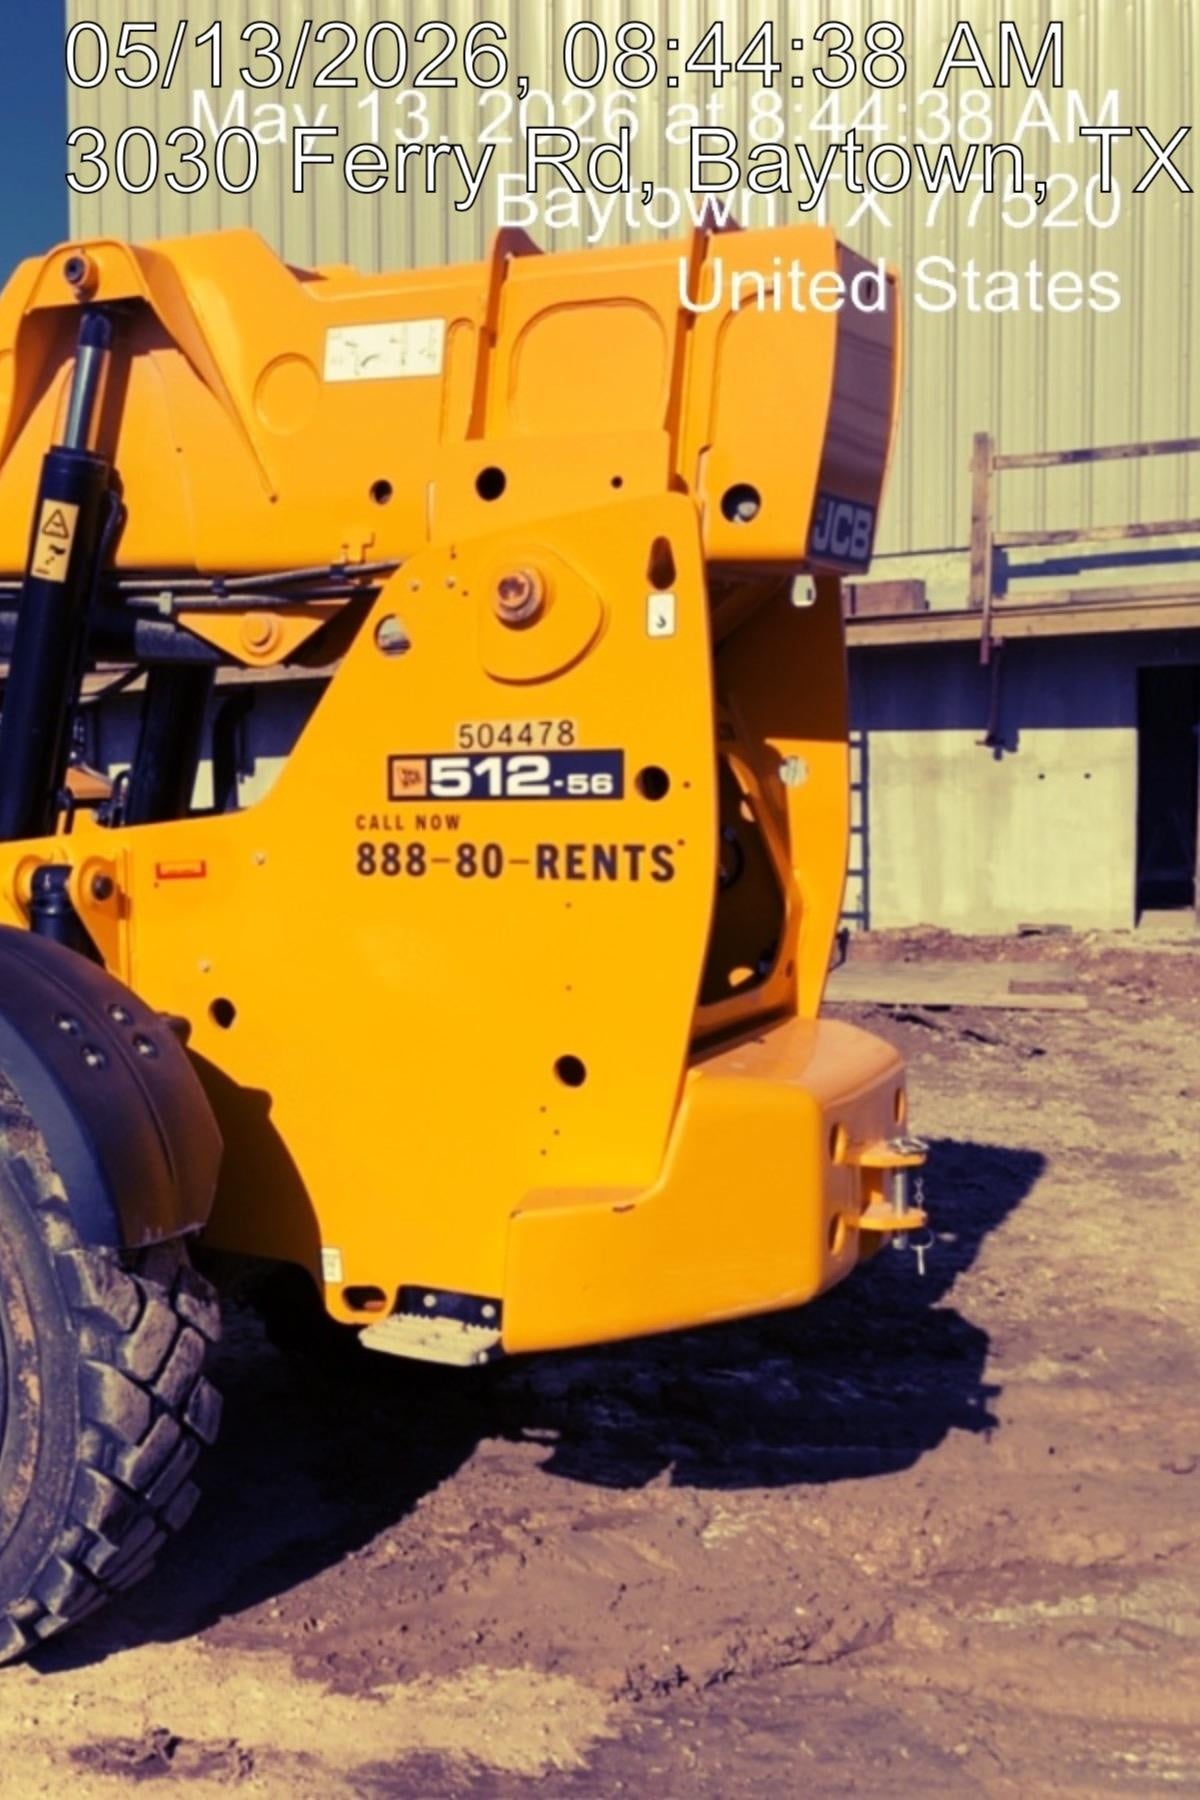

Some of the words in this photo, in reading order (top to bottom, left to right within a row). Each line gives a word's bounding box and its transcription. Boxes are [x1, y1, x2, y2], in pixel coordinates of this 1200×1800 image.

[812, 500, 872, 559] JCB
[458, 719, 576, 750] 504478
[355, 814, 404, 831] CALL
[415, 814, 460, 831] NOW
[356, 842, 676, 882] 888-80-RENTS
